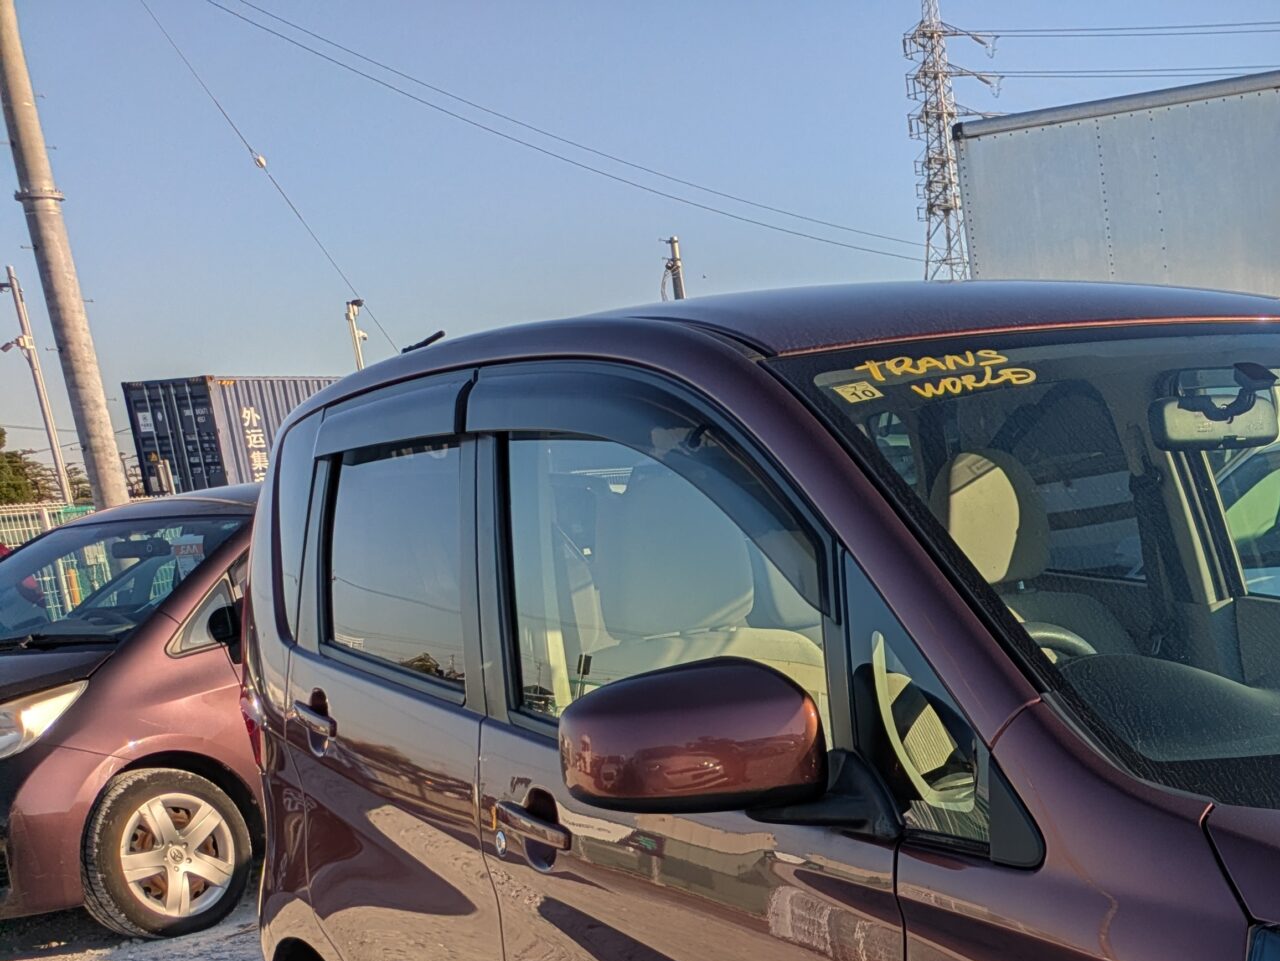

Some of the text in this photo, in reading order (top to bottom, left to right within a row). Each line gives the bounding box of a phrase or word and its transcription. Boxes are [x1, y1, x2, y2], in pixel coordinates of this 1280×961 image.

[854, 350, 1008, 381] TRANS
[850, 390, 876, 400] 10
[911, 366, 1037, 398] WORLD
